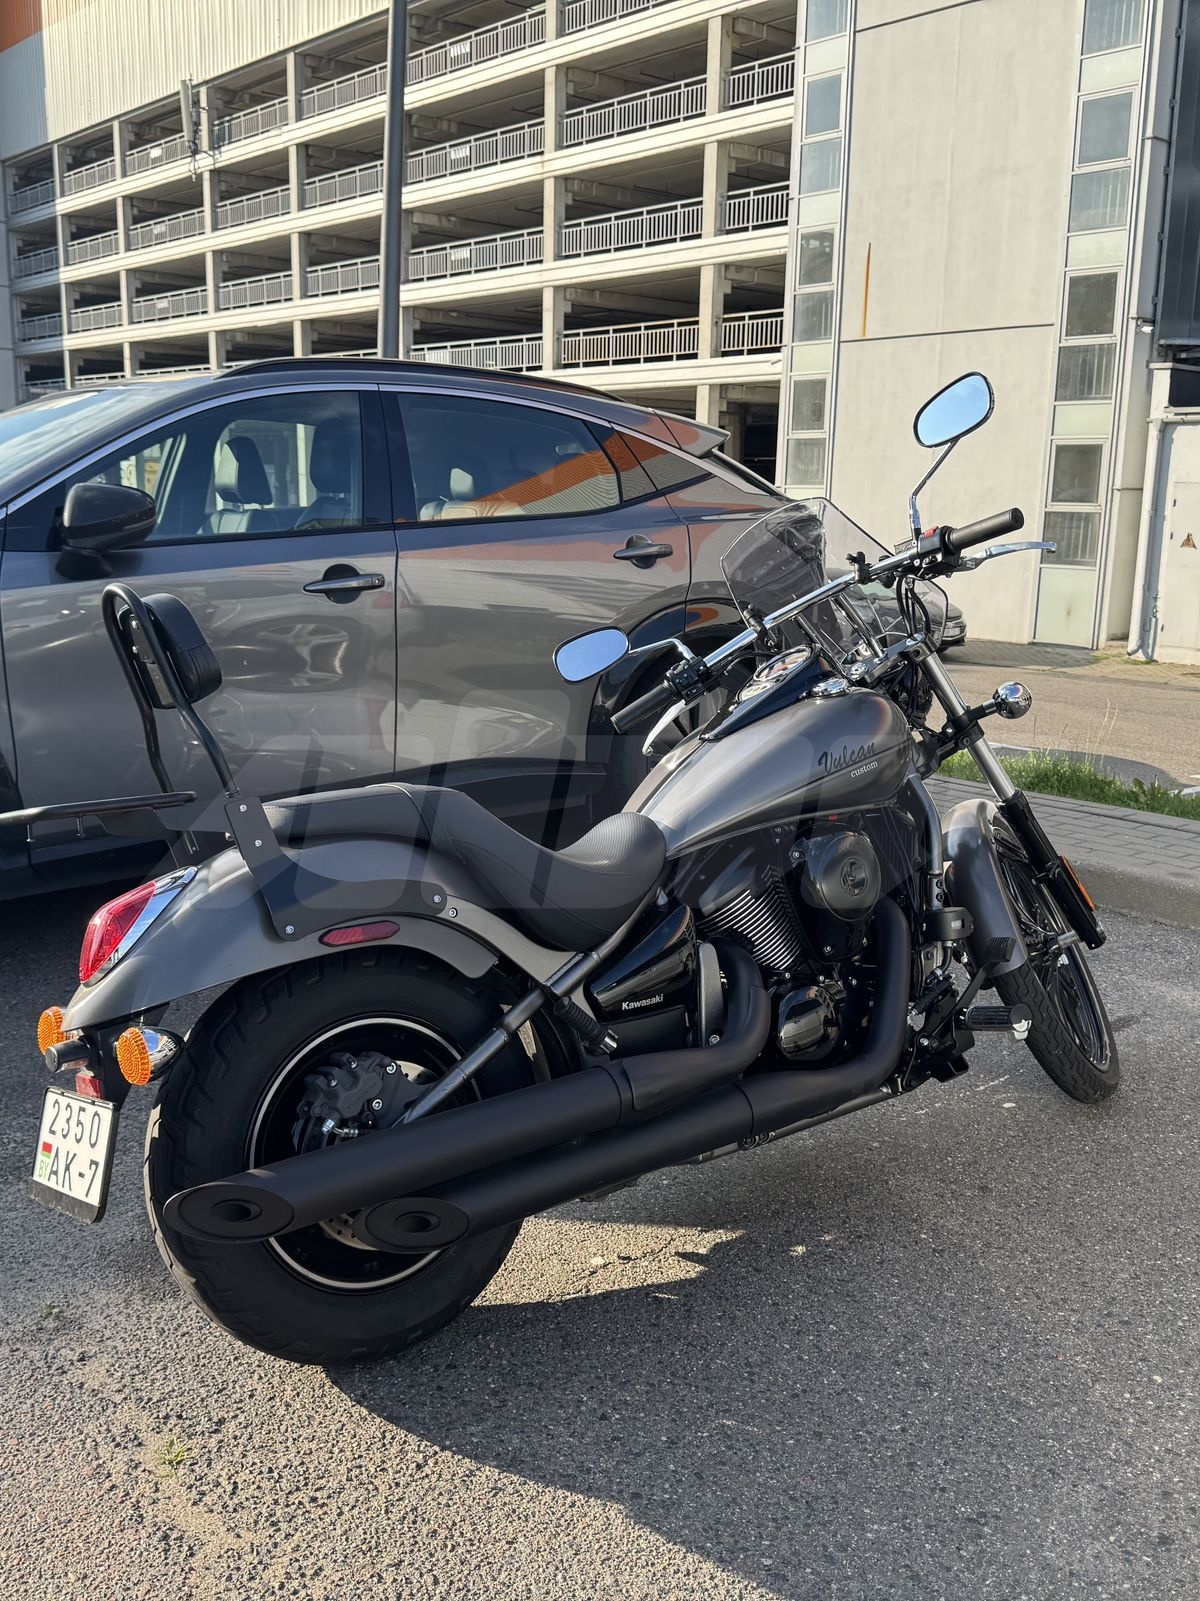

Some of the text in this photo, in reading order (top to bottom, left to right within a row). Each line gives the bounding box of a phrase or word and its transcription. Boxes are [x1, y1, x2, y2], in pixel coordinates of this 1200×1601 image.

[818, 742, 877, 773] Vulcan
[850, 761, 878, 778] custom
[622, 994, 664, 1010] Kawasaki
[48, 1098, 101, 1149] 2350
[38, 1160, 50, 1180] BY
[47, 1146, 99, 1198] AK-7
